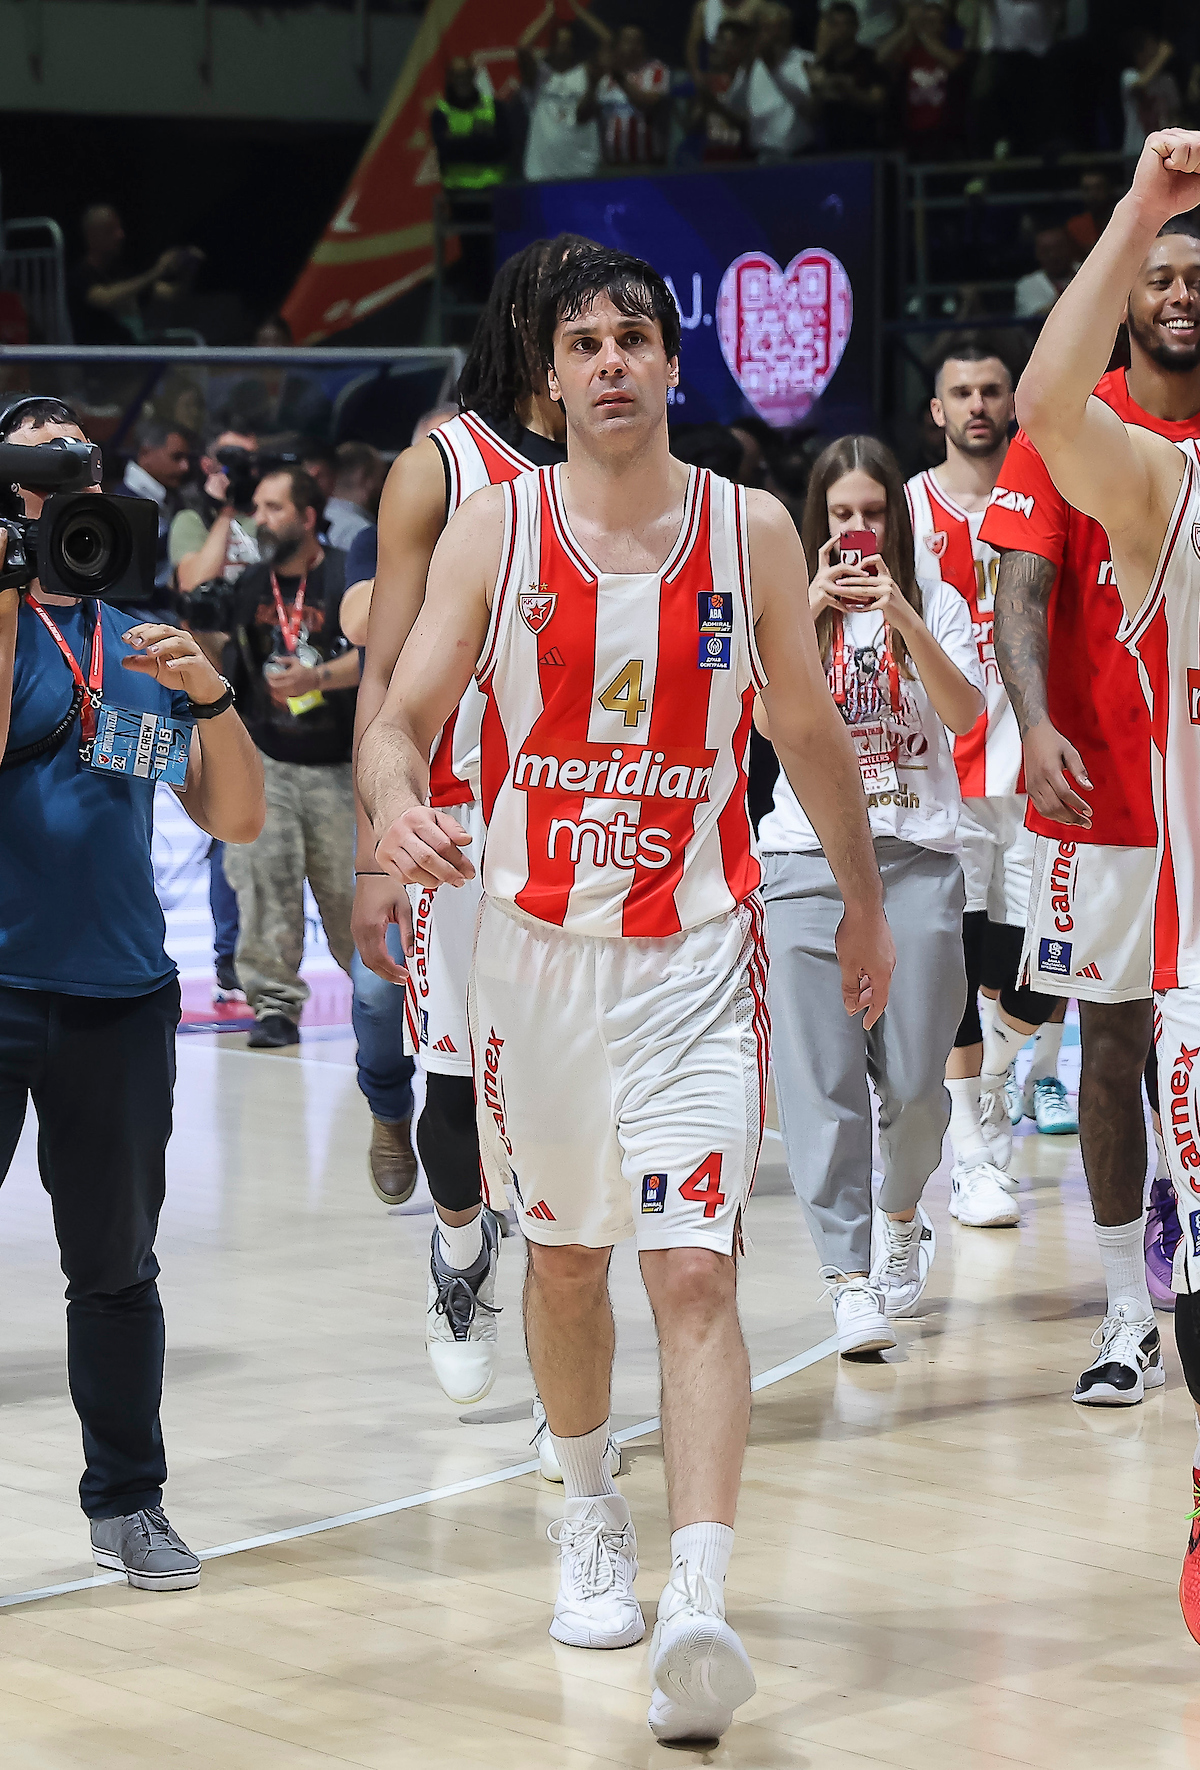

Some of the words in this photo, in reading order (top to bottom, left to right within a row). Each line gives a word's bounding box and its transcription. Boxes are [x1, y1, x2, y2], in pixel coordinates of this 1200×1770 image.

[598, 659, 647, 727] 4
[141, 724, 153, 751] CREW
[160, 730, 171, 740] 5
[112, 756, 127, 770] 24
[138, 752, 150, 765] TV
[158, 744, 169, 755] 3
[859, 754, 890, 765] UNTEERS
[514, 749, 714, 800] meridian
[865, 770, 876, 778] AA
[868, 793, 919, 809] досић
[547, 814, 672, 870] mts
[1051, 839, 1077, 932] carne
[415, 886, 439, 998] carnex
[484, 1025, 513, 1156] carnex
[678, 1151, 726, 1218] 4
